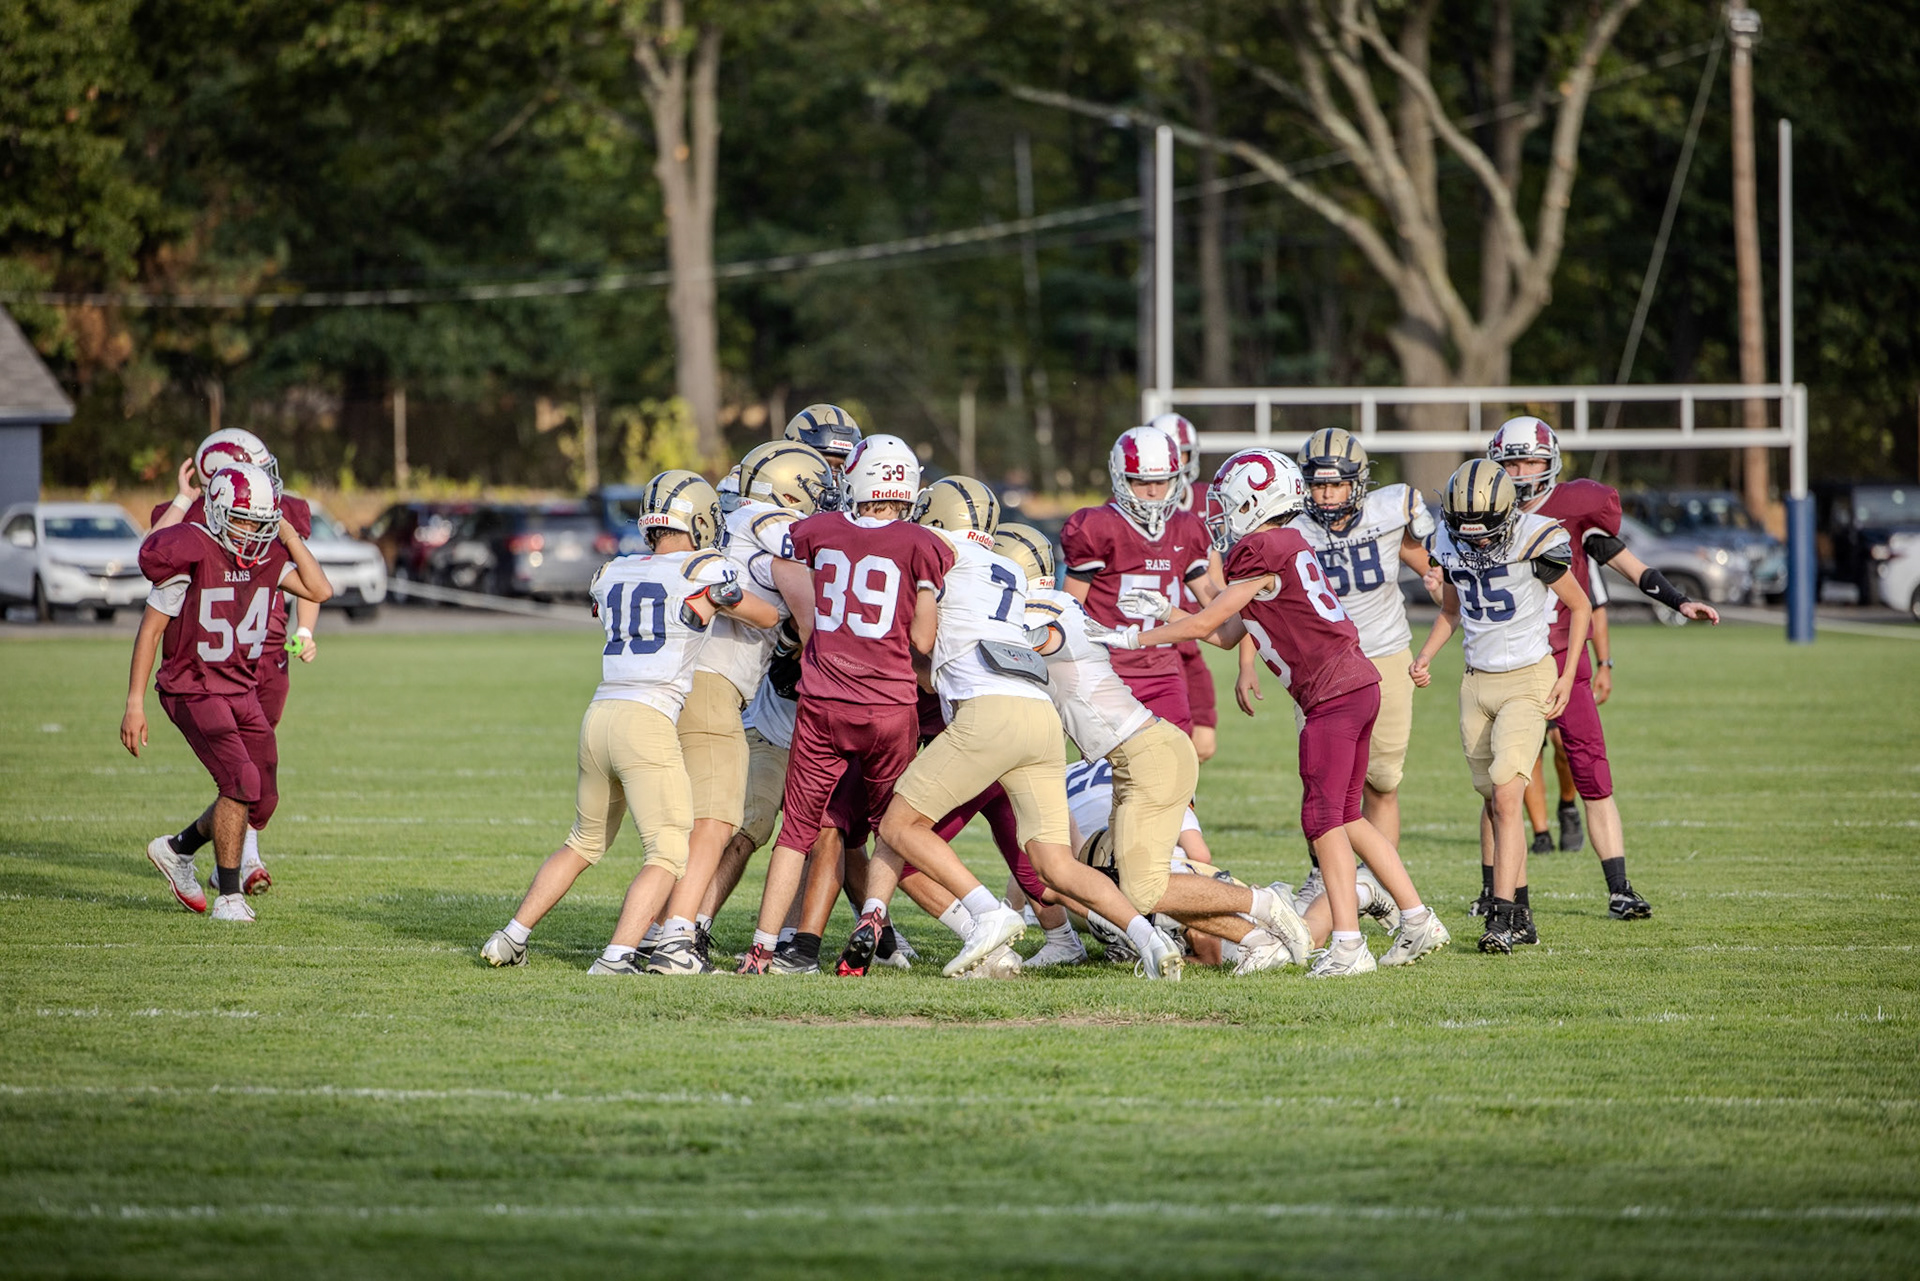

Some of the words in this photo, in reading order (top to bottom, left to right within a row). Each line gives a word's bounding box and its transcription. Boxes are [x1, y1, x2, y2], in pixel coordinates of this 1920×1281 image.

[639, 516, 669, 527] Riddell
[871, 489, 911, 499] Riddell
[224, 570, 251, 582] RAMS
[814, 548, 901, 639] 39
[988, 563, 1017, 622] 7
[1145, 559, 1171, 571] RAMS
[1316, 540, 1385, 597] 58
[1451, 564, 1516, 622] 35
[197, 586, 270, 662] 54
[603, 582, 668, 655] 10
